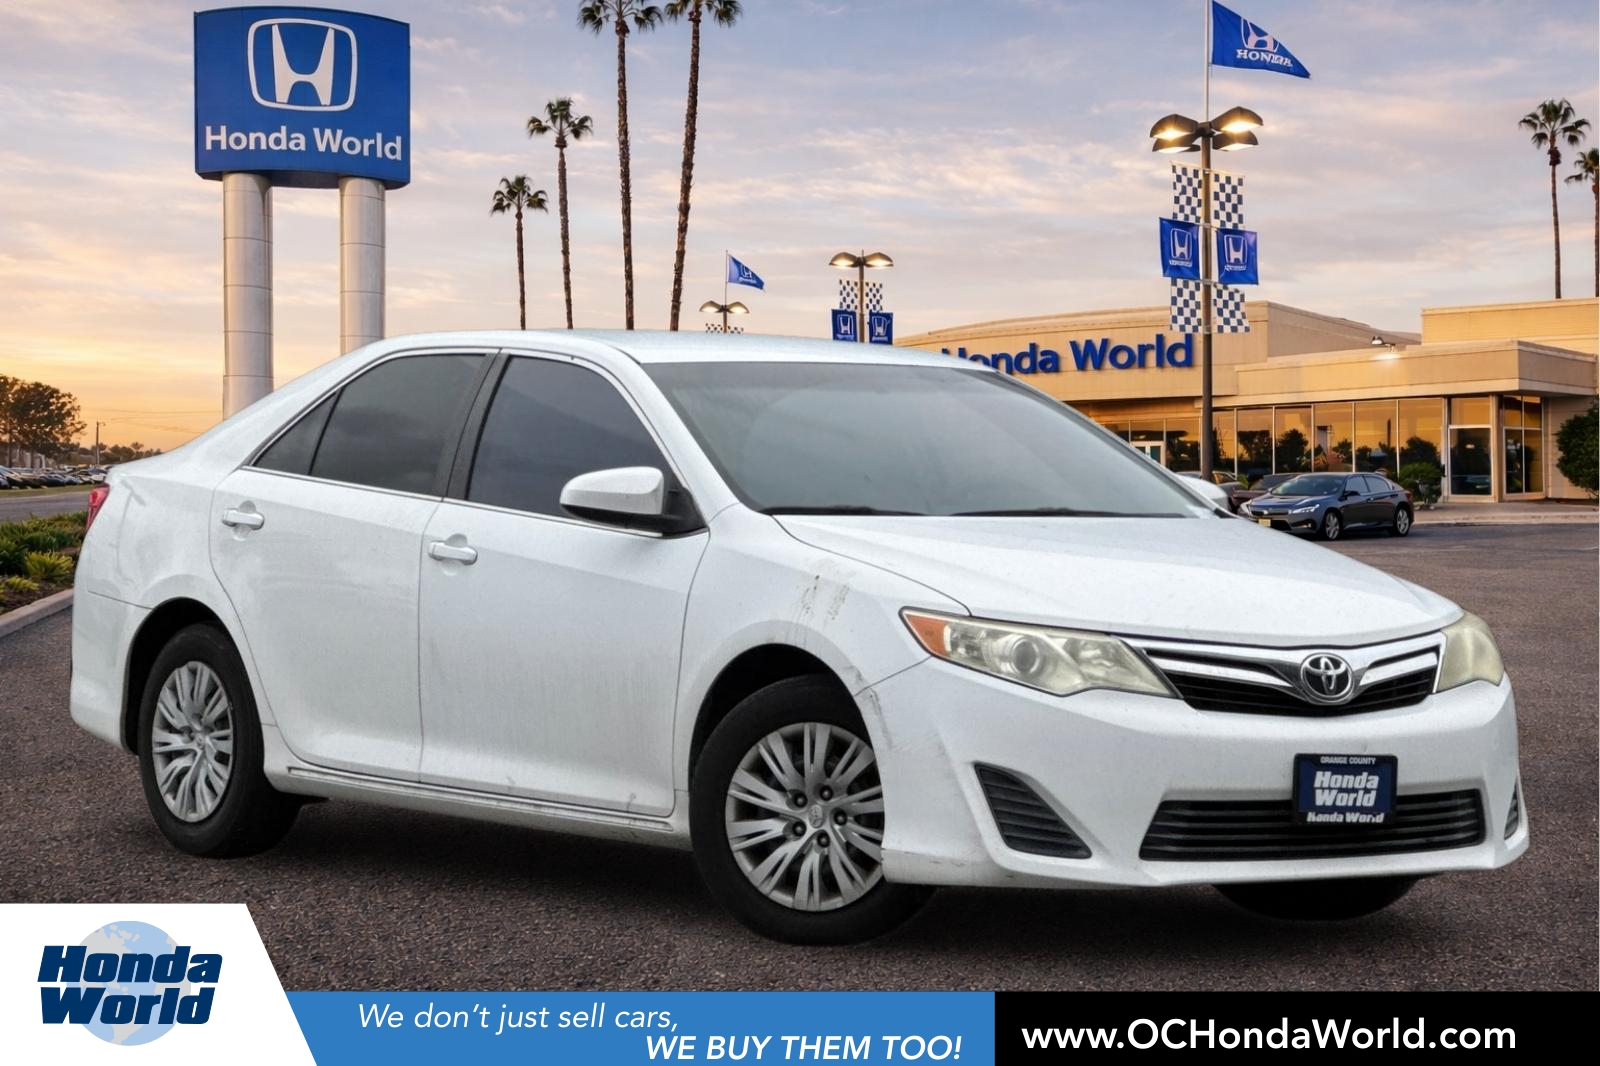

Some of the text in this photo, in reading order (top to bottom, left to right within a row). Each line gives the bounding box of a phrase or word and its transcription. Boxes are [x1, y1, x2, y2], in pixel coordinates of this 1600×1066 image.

[205, 125, 402, 161] Honda World
[1069, 333, 1194, 371] World
[1320, 756, 1376, 765] ORANGE COUNTY
[1314, 770, 1380, 789] Honda
[1315, 789, 1377, 807] World
